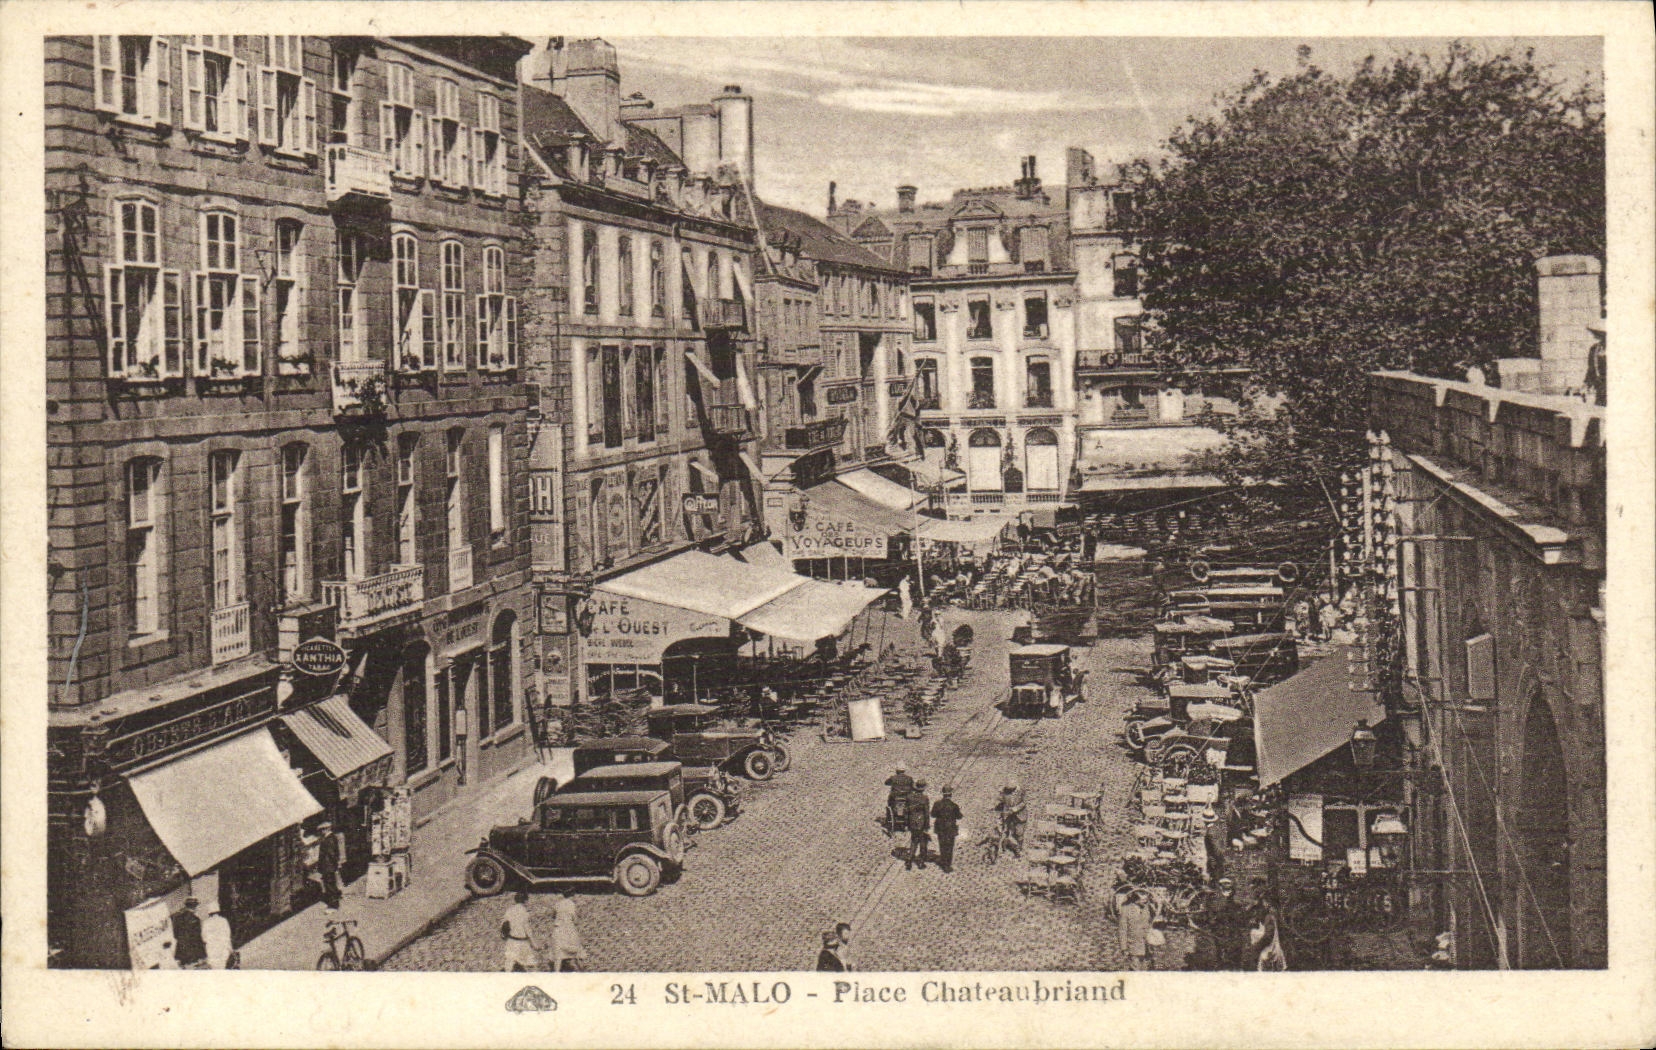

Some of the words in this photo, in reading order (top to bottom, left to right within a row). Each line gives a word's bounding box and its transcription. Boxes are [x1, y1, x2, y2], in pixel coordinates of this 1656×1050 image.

[815, 520, 855, 532] CAFÉ
[791, 536, 883, 549] VOYAGEURS
[586, 597, 630, 617] CAFÉ
[295, 653, 343, 663] XANTHIA
